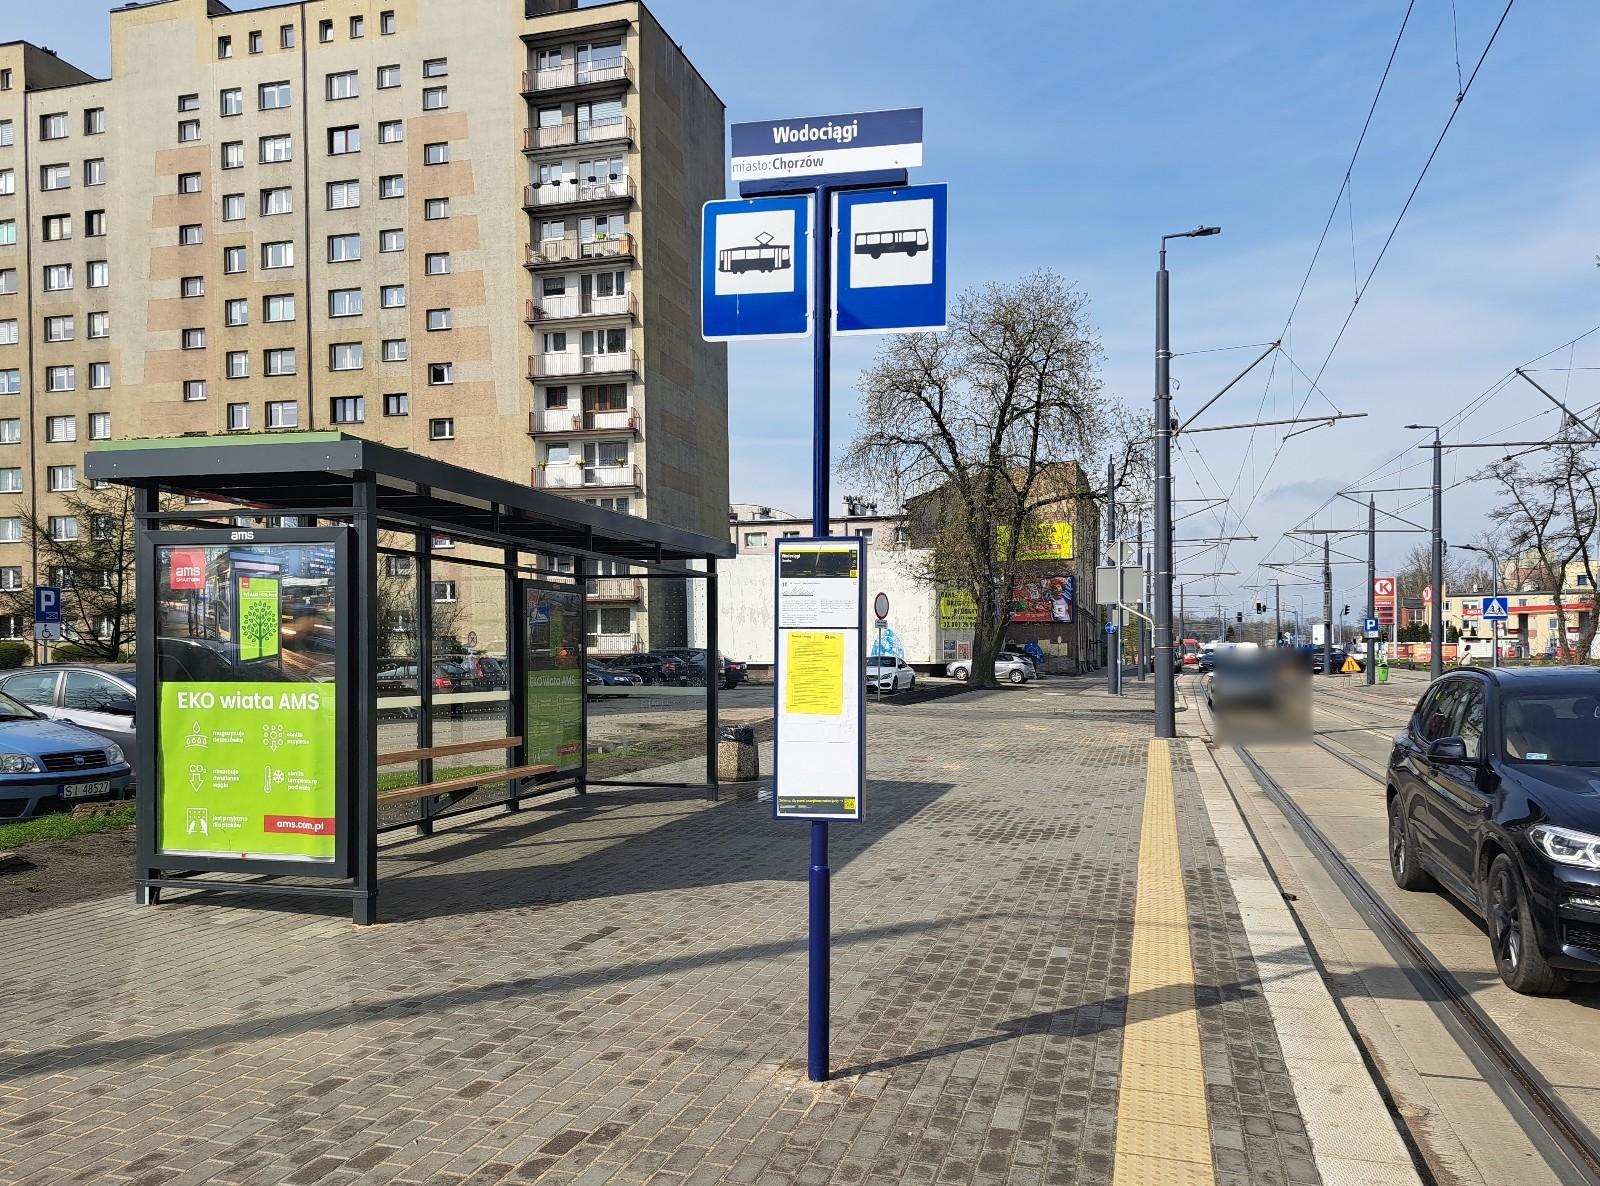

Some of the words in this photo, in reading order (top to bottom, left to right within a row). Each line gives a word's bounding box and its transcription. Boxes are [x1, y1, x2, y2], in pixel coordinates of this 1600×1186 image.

[772, 119, 858, 144] Wodociągi
[231, 531, 254, 541] ams
[176, 566, 201, 577] ams
[1379, 582, 1390, 593] K
[40, 590, 56, 612] P
[1366, 619, 1376, 630] P
[561, 675, 576, 686] AMS
[177, 691, 215, 709] EKO
[219, 690, 274, 709] wiata
[278, 692, 320, 710] AMS
[82, 781, 109, 795] 48527
[276, 820, 324, 833] ams.com.pl
